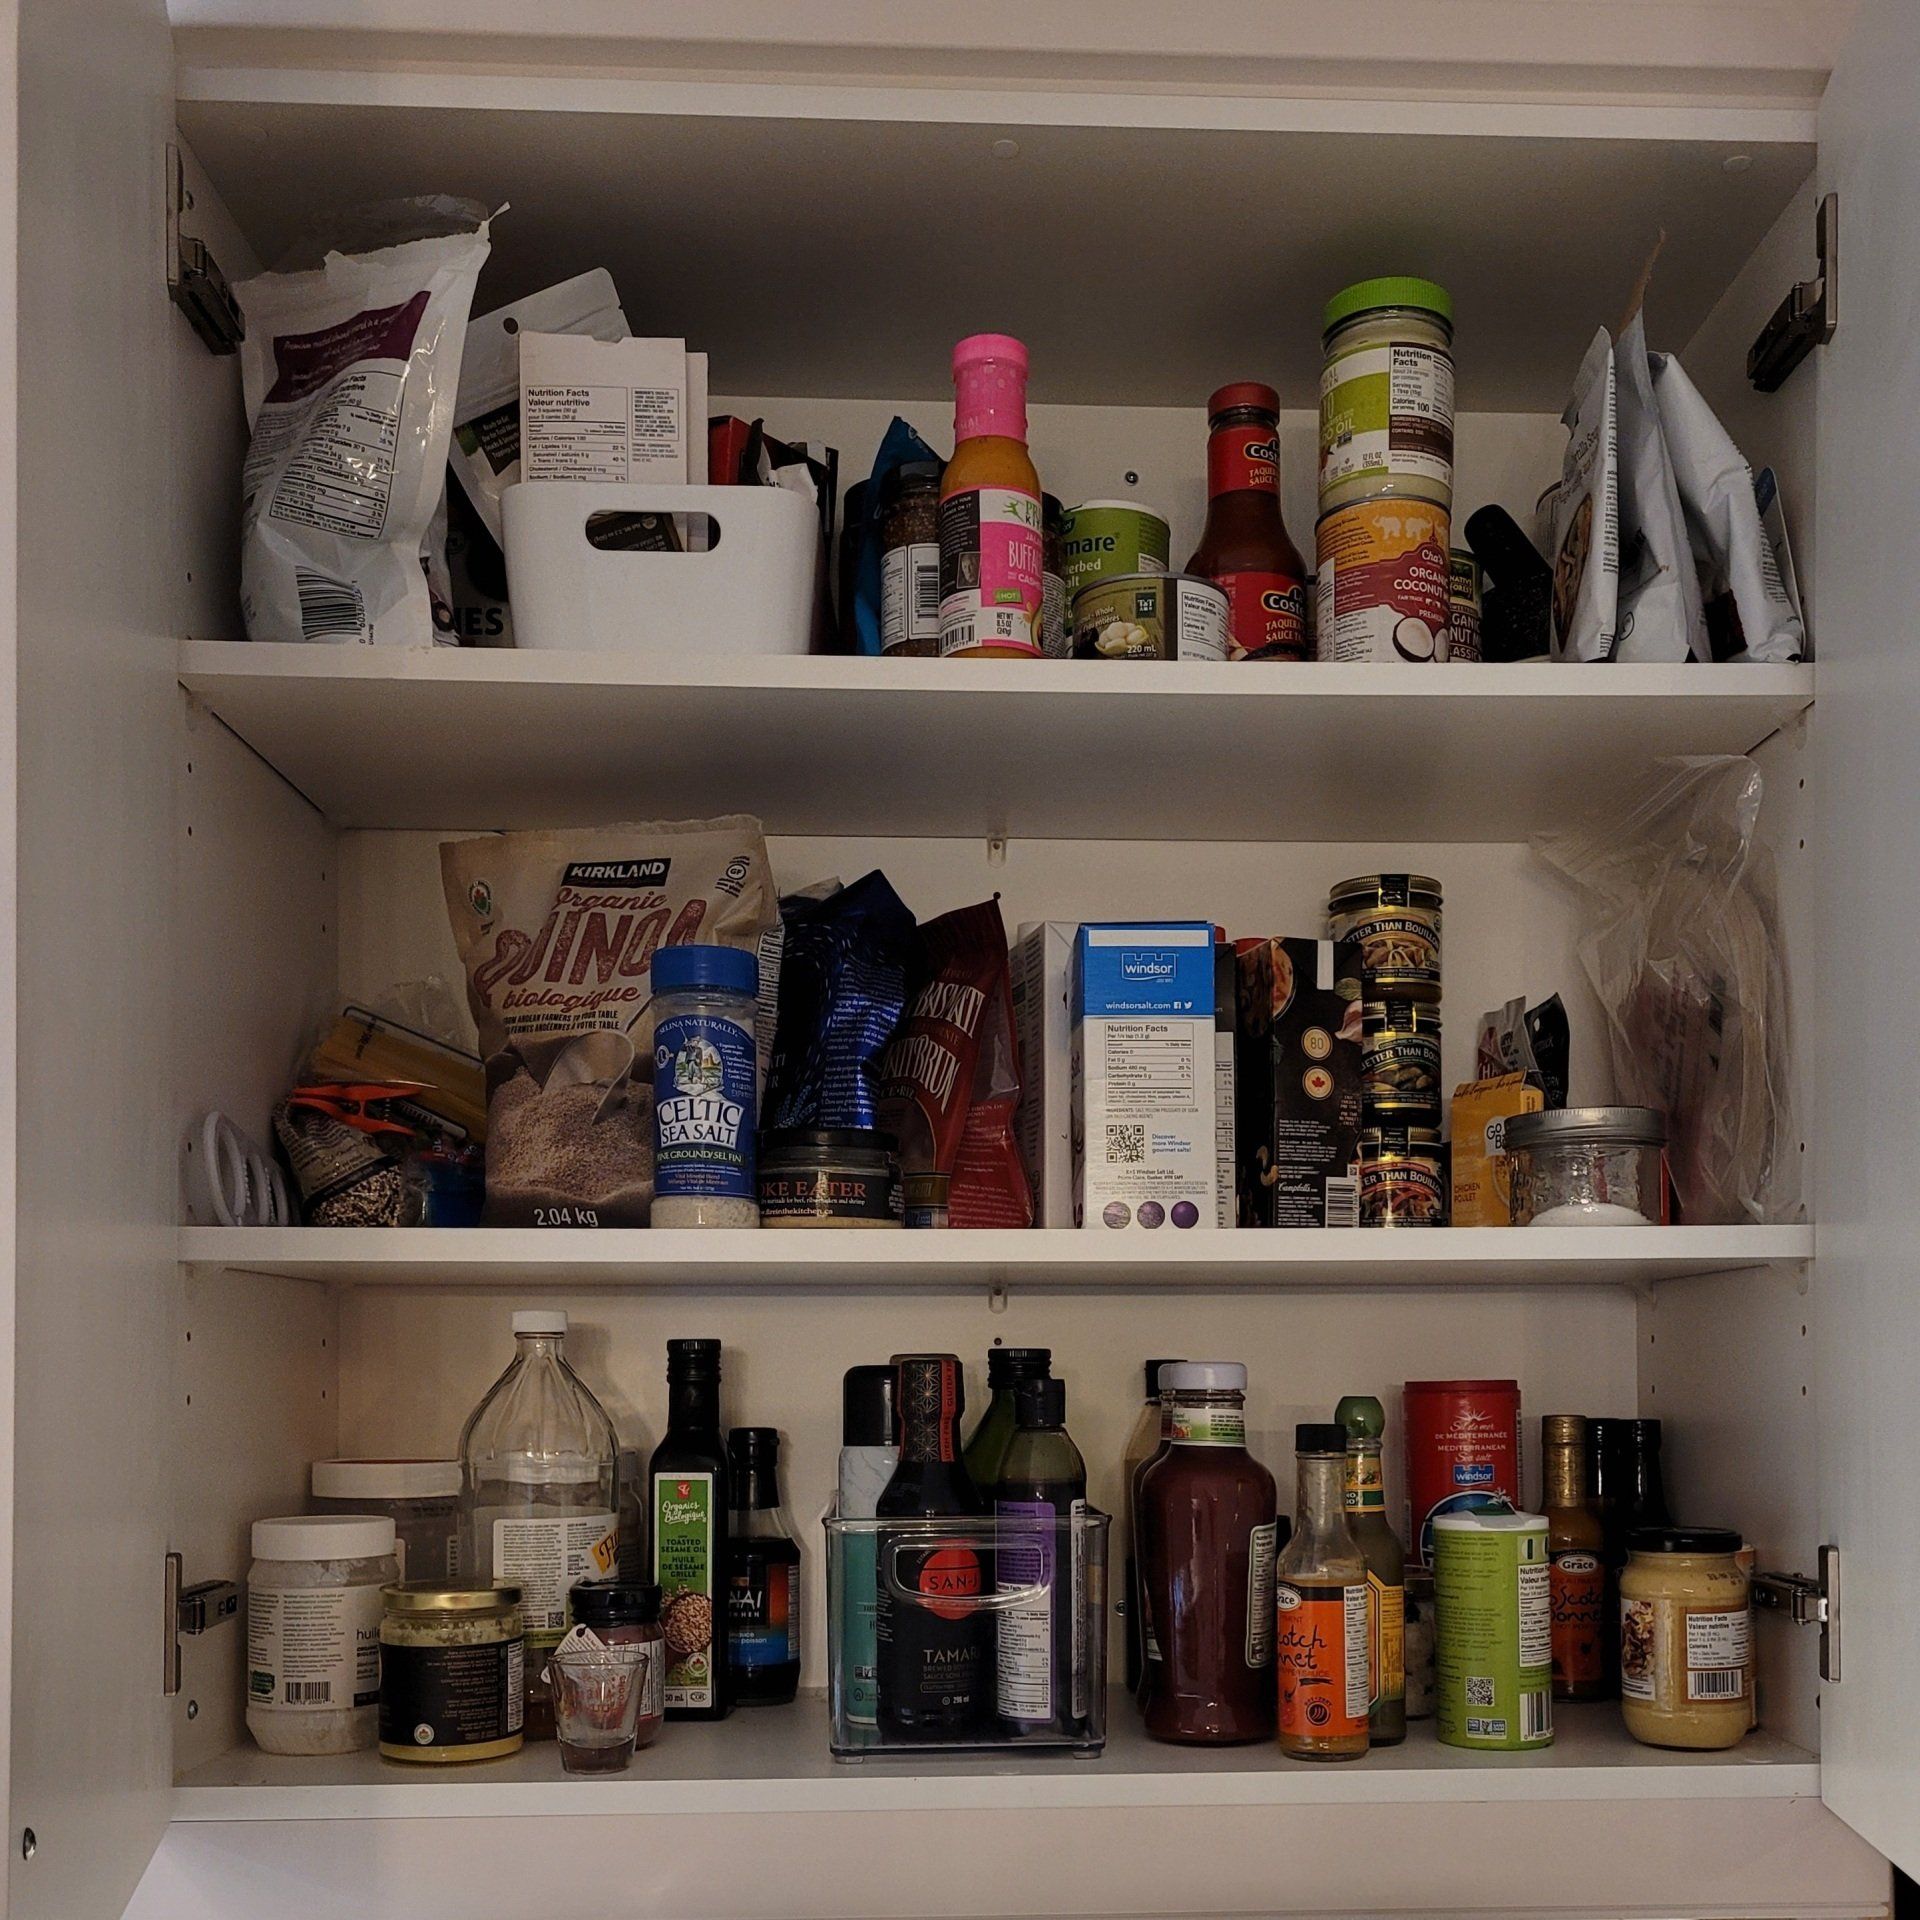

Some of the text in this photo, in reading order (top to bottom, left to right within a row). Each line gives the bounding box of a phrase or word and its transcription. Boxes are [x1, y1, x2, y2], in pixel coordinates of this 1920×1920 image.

[1393, 349, 1432, 361] Nutrition
[1393, 358, 1418, 367] Facts
[528, 398, 554, 406] Valeur
[1250, 476, 1270, 487] SAUCE
[1394, 579, 1442, 597] COCONUT
[1266, 631, 1294, 644] SAUCE
[1128, 644, 1156, 654] 220 mL
[570, 860, 666, 880] KIRKLAND
[556, 888, 667, 912] Organic
[1374, 921, 1403, 932] THAN
[473, 899, 707, 1008] QUINOA
[1124, 962, 1174, 974] windsor
[502, 982, 641, 1014] biologique
[1106, 1002, 1171, 1010] windsorsalt.com
[598, 1010, 618, 1019] TABLE
[598, 1021, 620, 1030] TABLE
[1310, 1036, 1324, 1050] 80
[1397, 1046, 1422, 1057] THAN
[659, 1100, 740, 1127] CELTIC
[662, 1124, 690, 1145] SEA
[1378, 1170, 1408, 1181] THAN
[796, 1181, 867, 1198] EATER
[1454, 1182, 1481, 1194] CHICKEN
[533, 1207, 598, 1227] 2.04 kg
[1456, 1472, 1492, 1481] windsor
[662, 1500, 700, 1512] Organics
[666, 1538, 702, 1546] TOASTED
[661, 1546, 691, 1554] SESAME
[672, 1556, 695, 1564] HUILE
[1562, 1560, 1594, 1570] Grace
[929, 1572, 978, 1591] SAN-J
